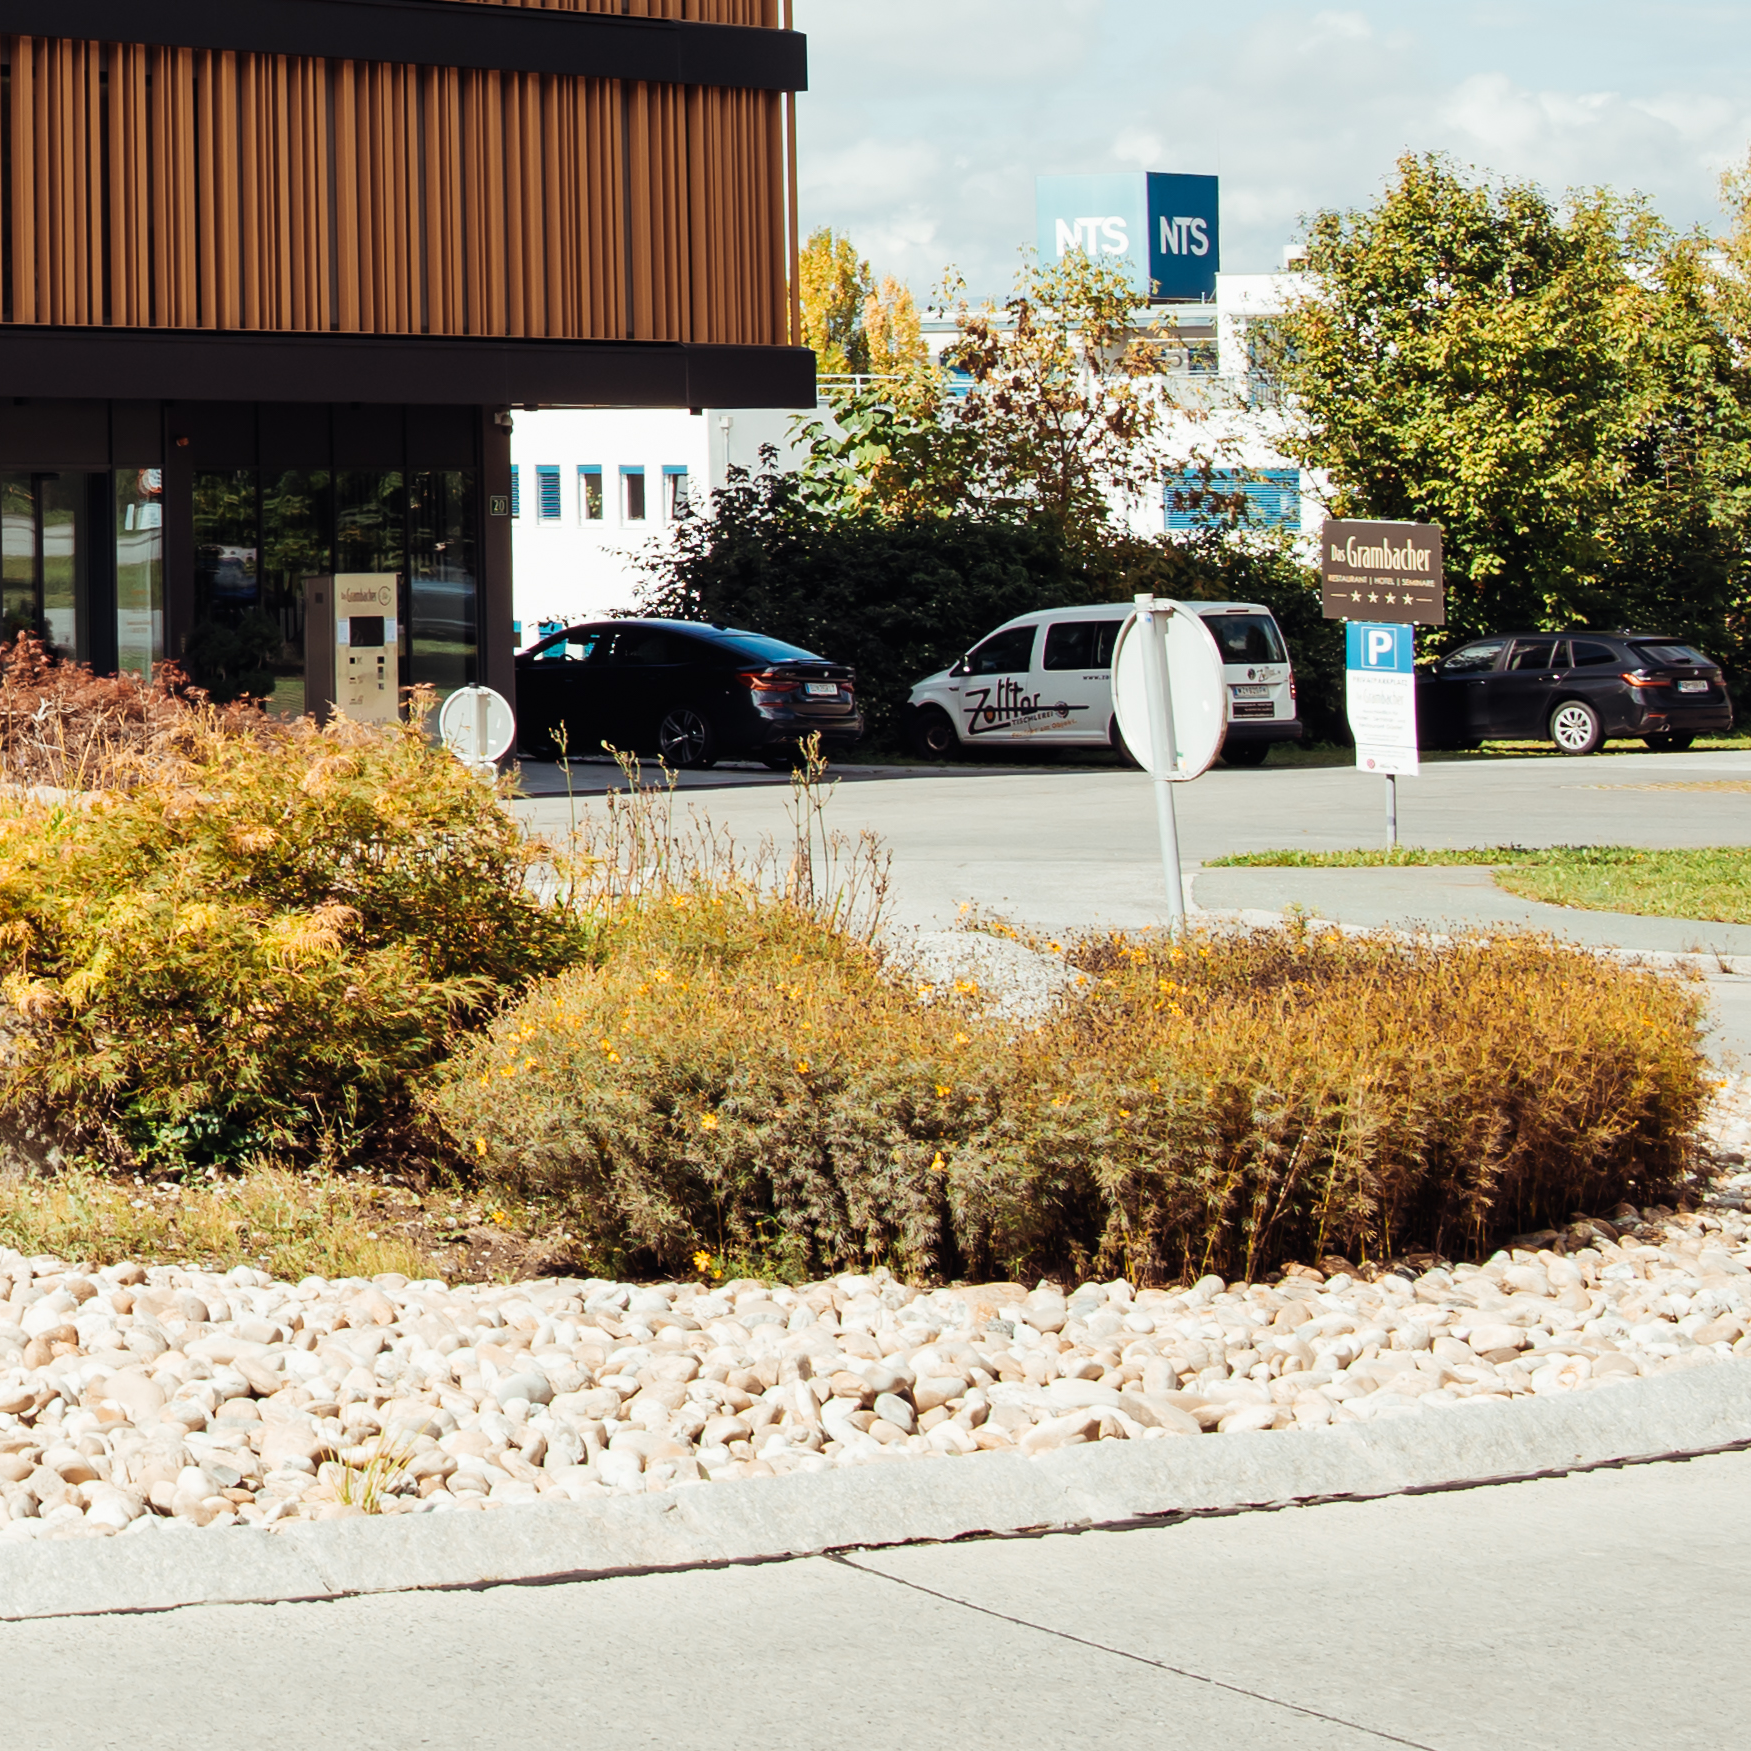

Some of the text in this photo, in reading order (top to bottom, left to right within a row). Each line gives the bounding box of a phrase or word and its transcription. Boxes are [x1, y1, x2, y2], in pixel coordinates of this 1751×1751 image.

[1054, 215, 1130, 257] NTS
[1158, 215, 1210, 257] NTS
[493, 499, 505, 511] 20
[1330, 535, 1432, 572] Das Grambacher
[1327, 573, 1436, 588] RESTAURANT HOTEL SEMINARE
[1368, 629, 1393, 666] P
[1011, 710, 1054, 726] TISCHLEREI
